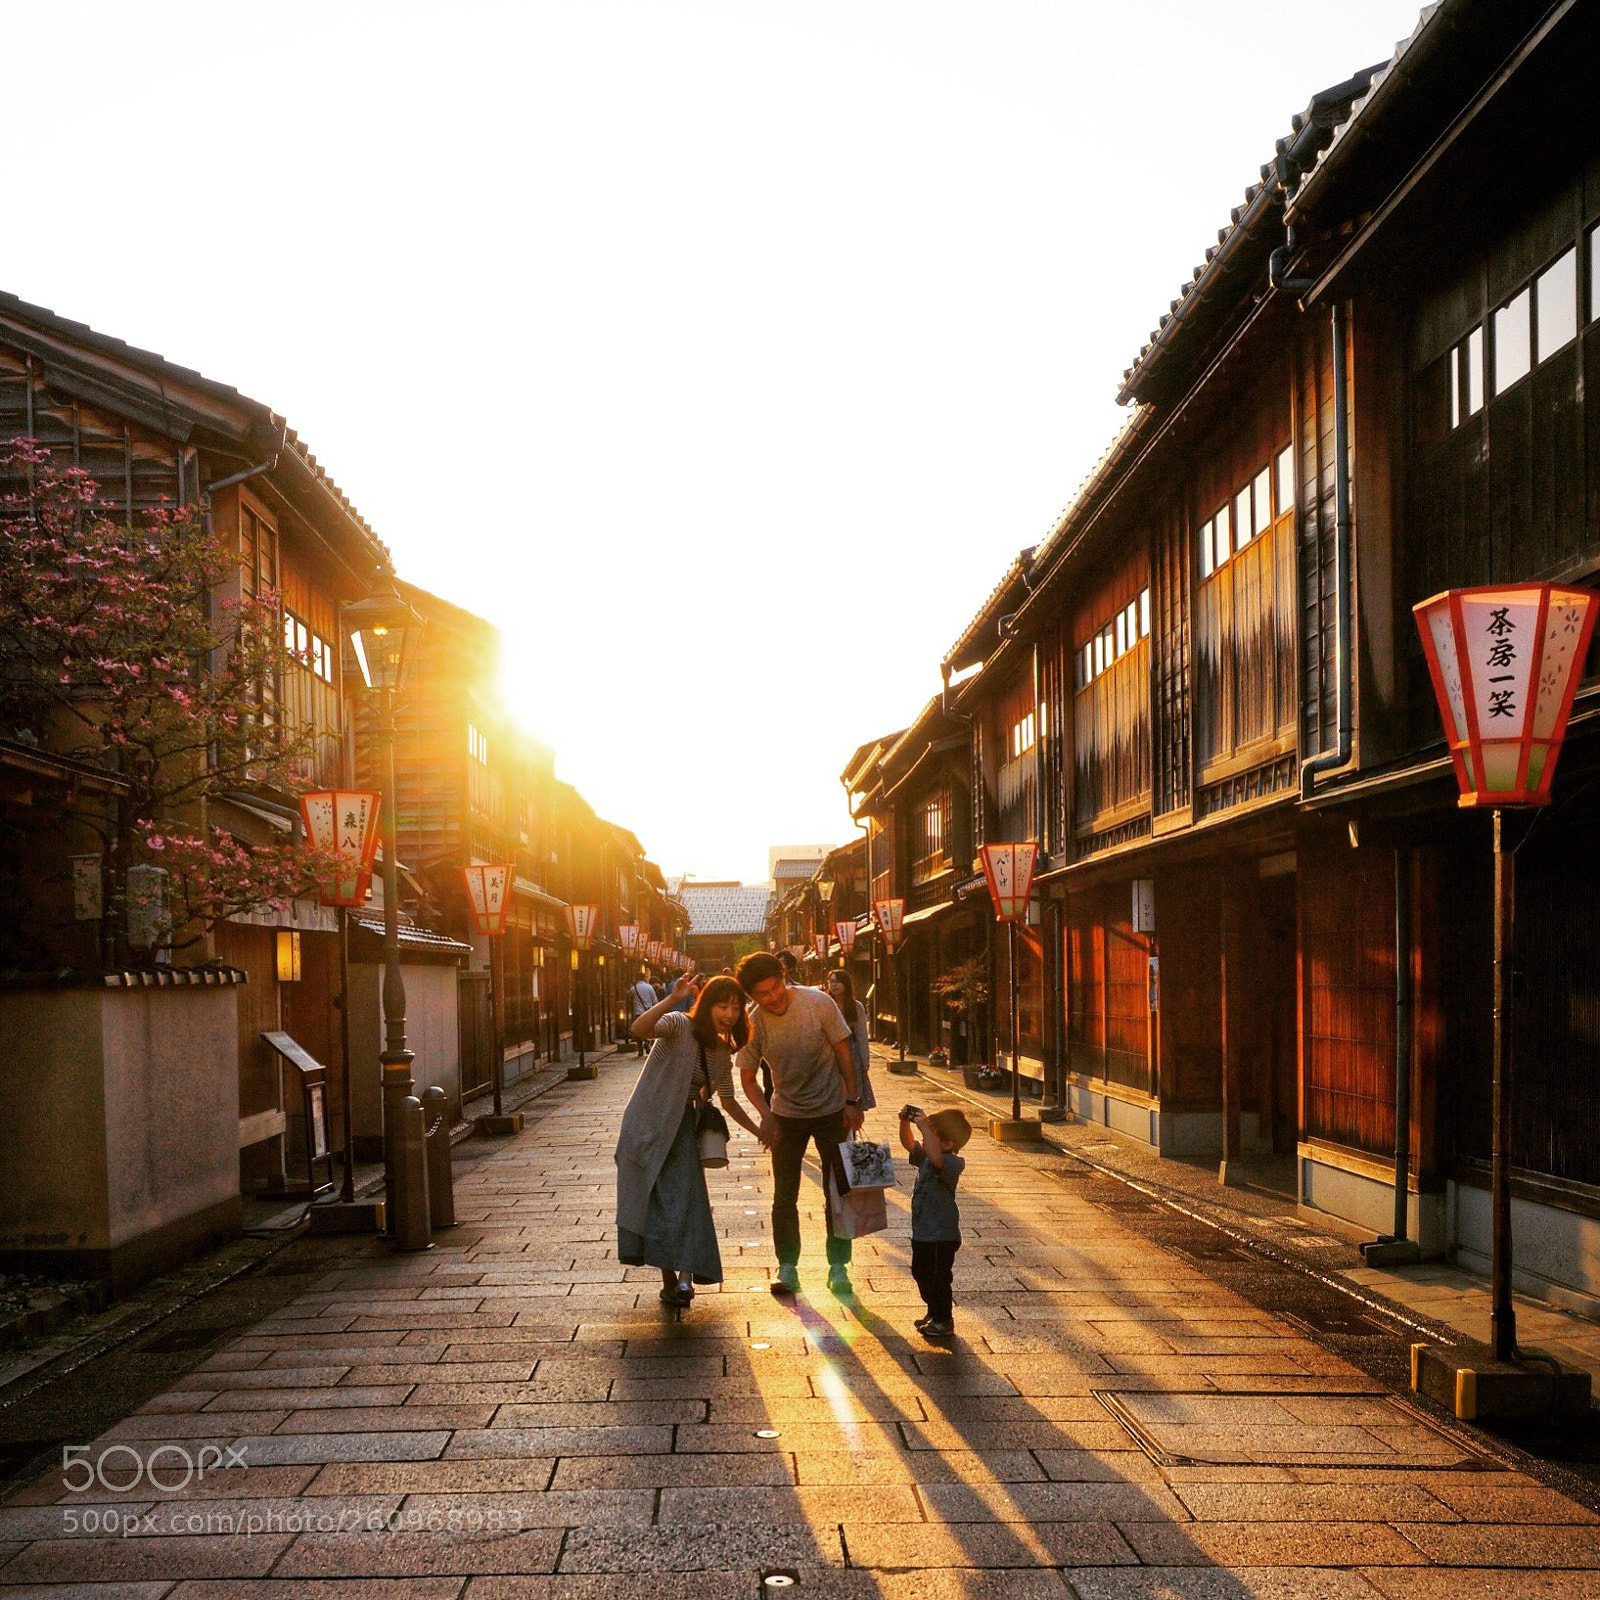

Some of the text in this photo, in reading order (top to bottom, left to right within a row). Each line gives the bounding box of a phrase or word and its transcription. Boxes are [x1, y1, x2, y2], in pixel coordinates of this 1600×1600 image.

[1486, 607, 1517, 719] 茶房一笑
[341, 811, 358, 848] 森八
